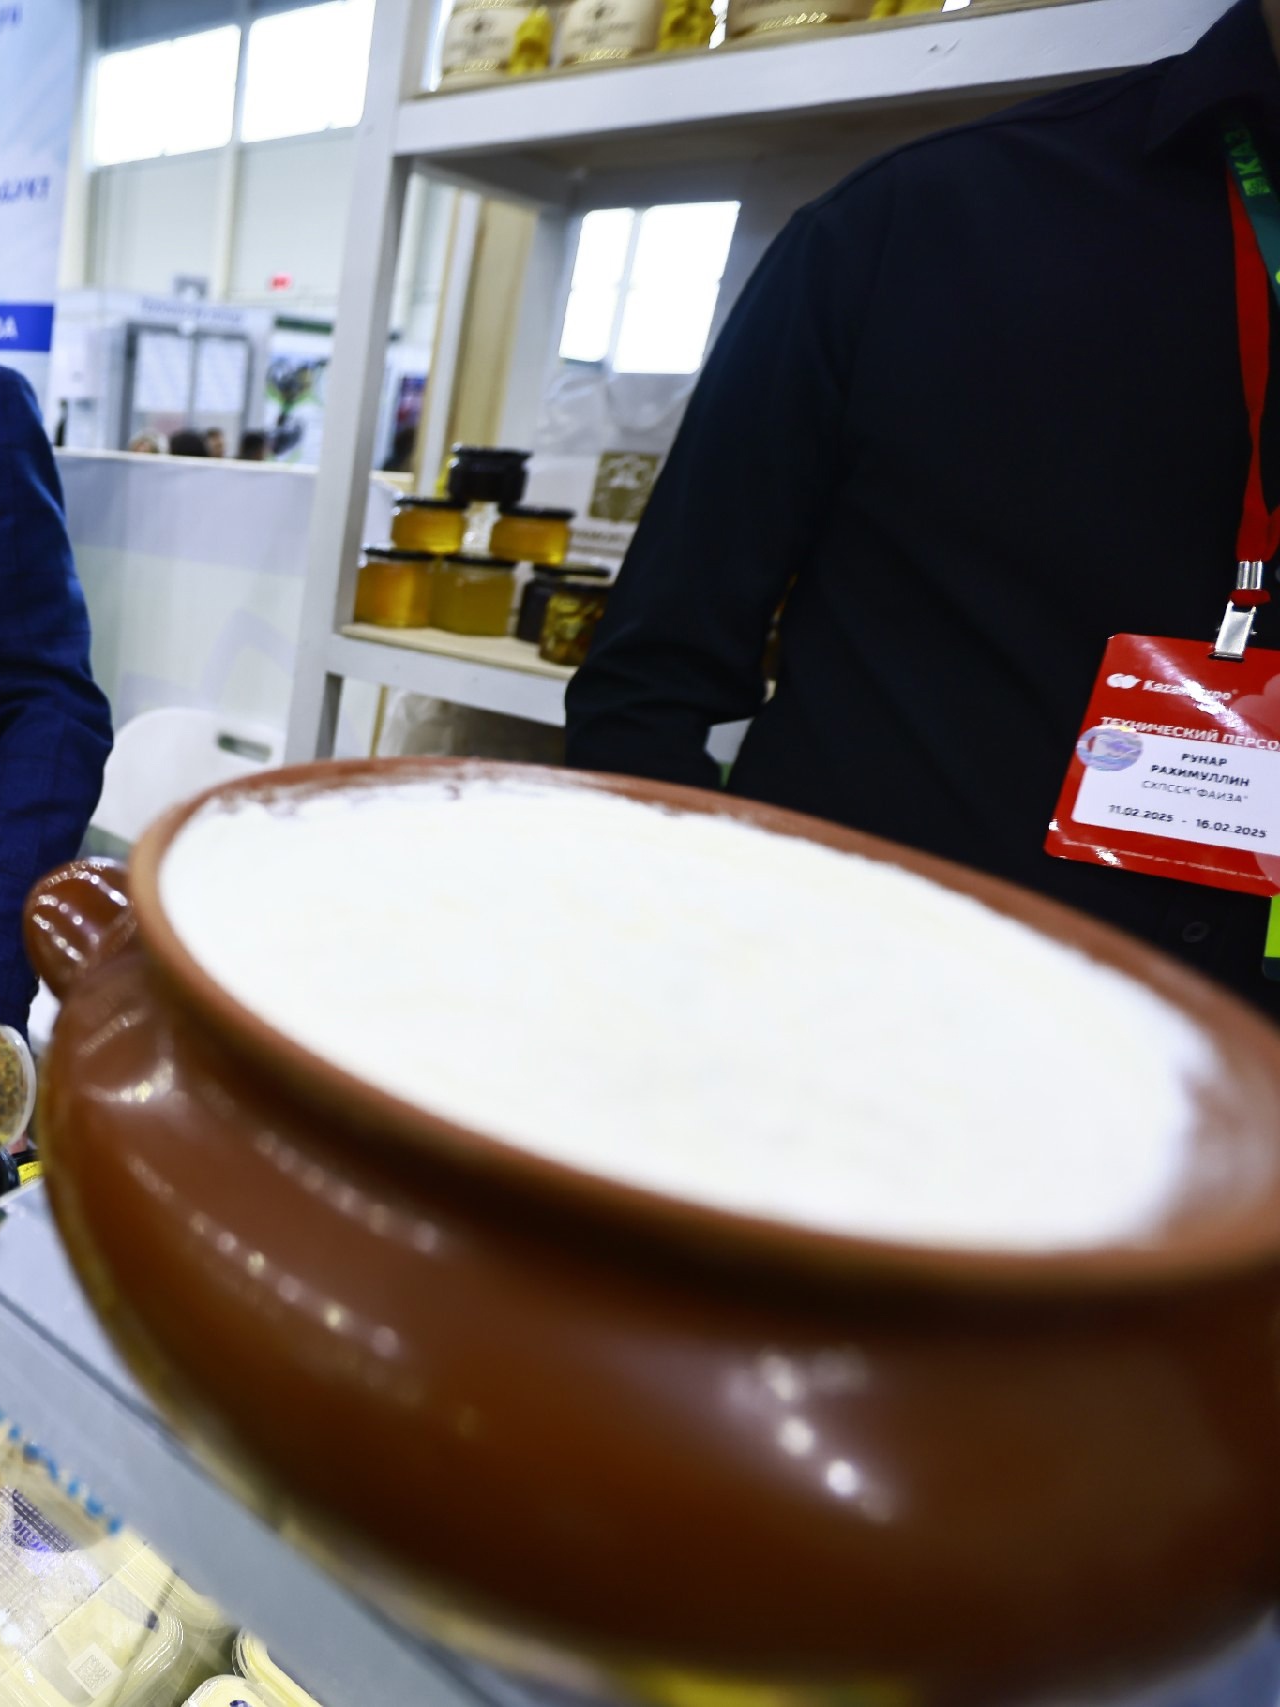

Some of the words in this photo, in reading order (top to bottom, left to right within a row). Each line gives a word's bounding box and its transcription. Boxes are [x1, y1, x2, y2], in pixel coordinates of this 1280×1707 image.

[1142, 679, 1191, 697] Kaza
[1223, 733, 1280, 752] ПЕРСО
[1181, 752, 1228, 766] РУНАР
[1151, 764, 1250, 788] РАХИМУЛЛИН
[1109, 804, 1174, 823] 11.02.2025
[1196, 816, 1267, 839] 16.02.2025
